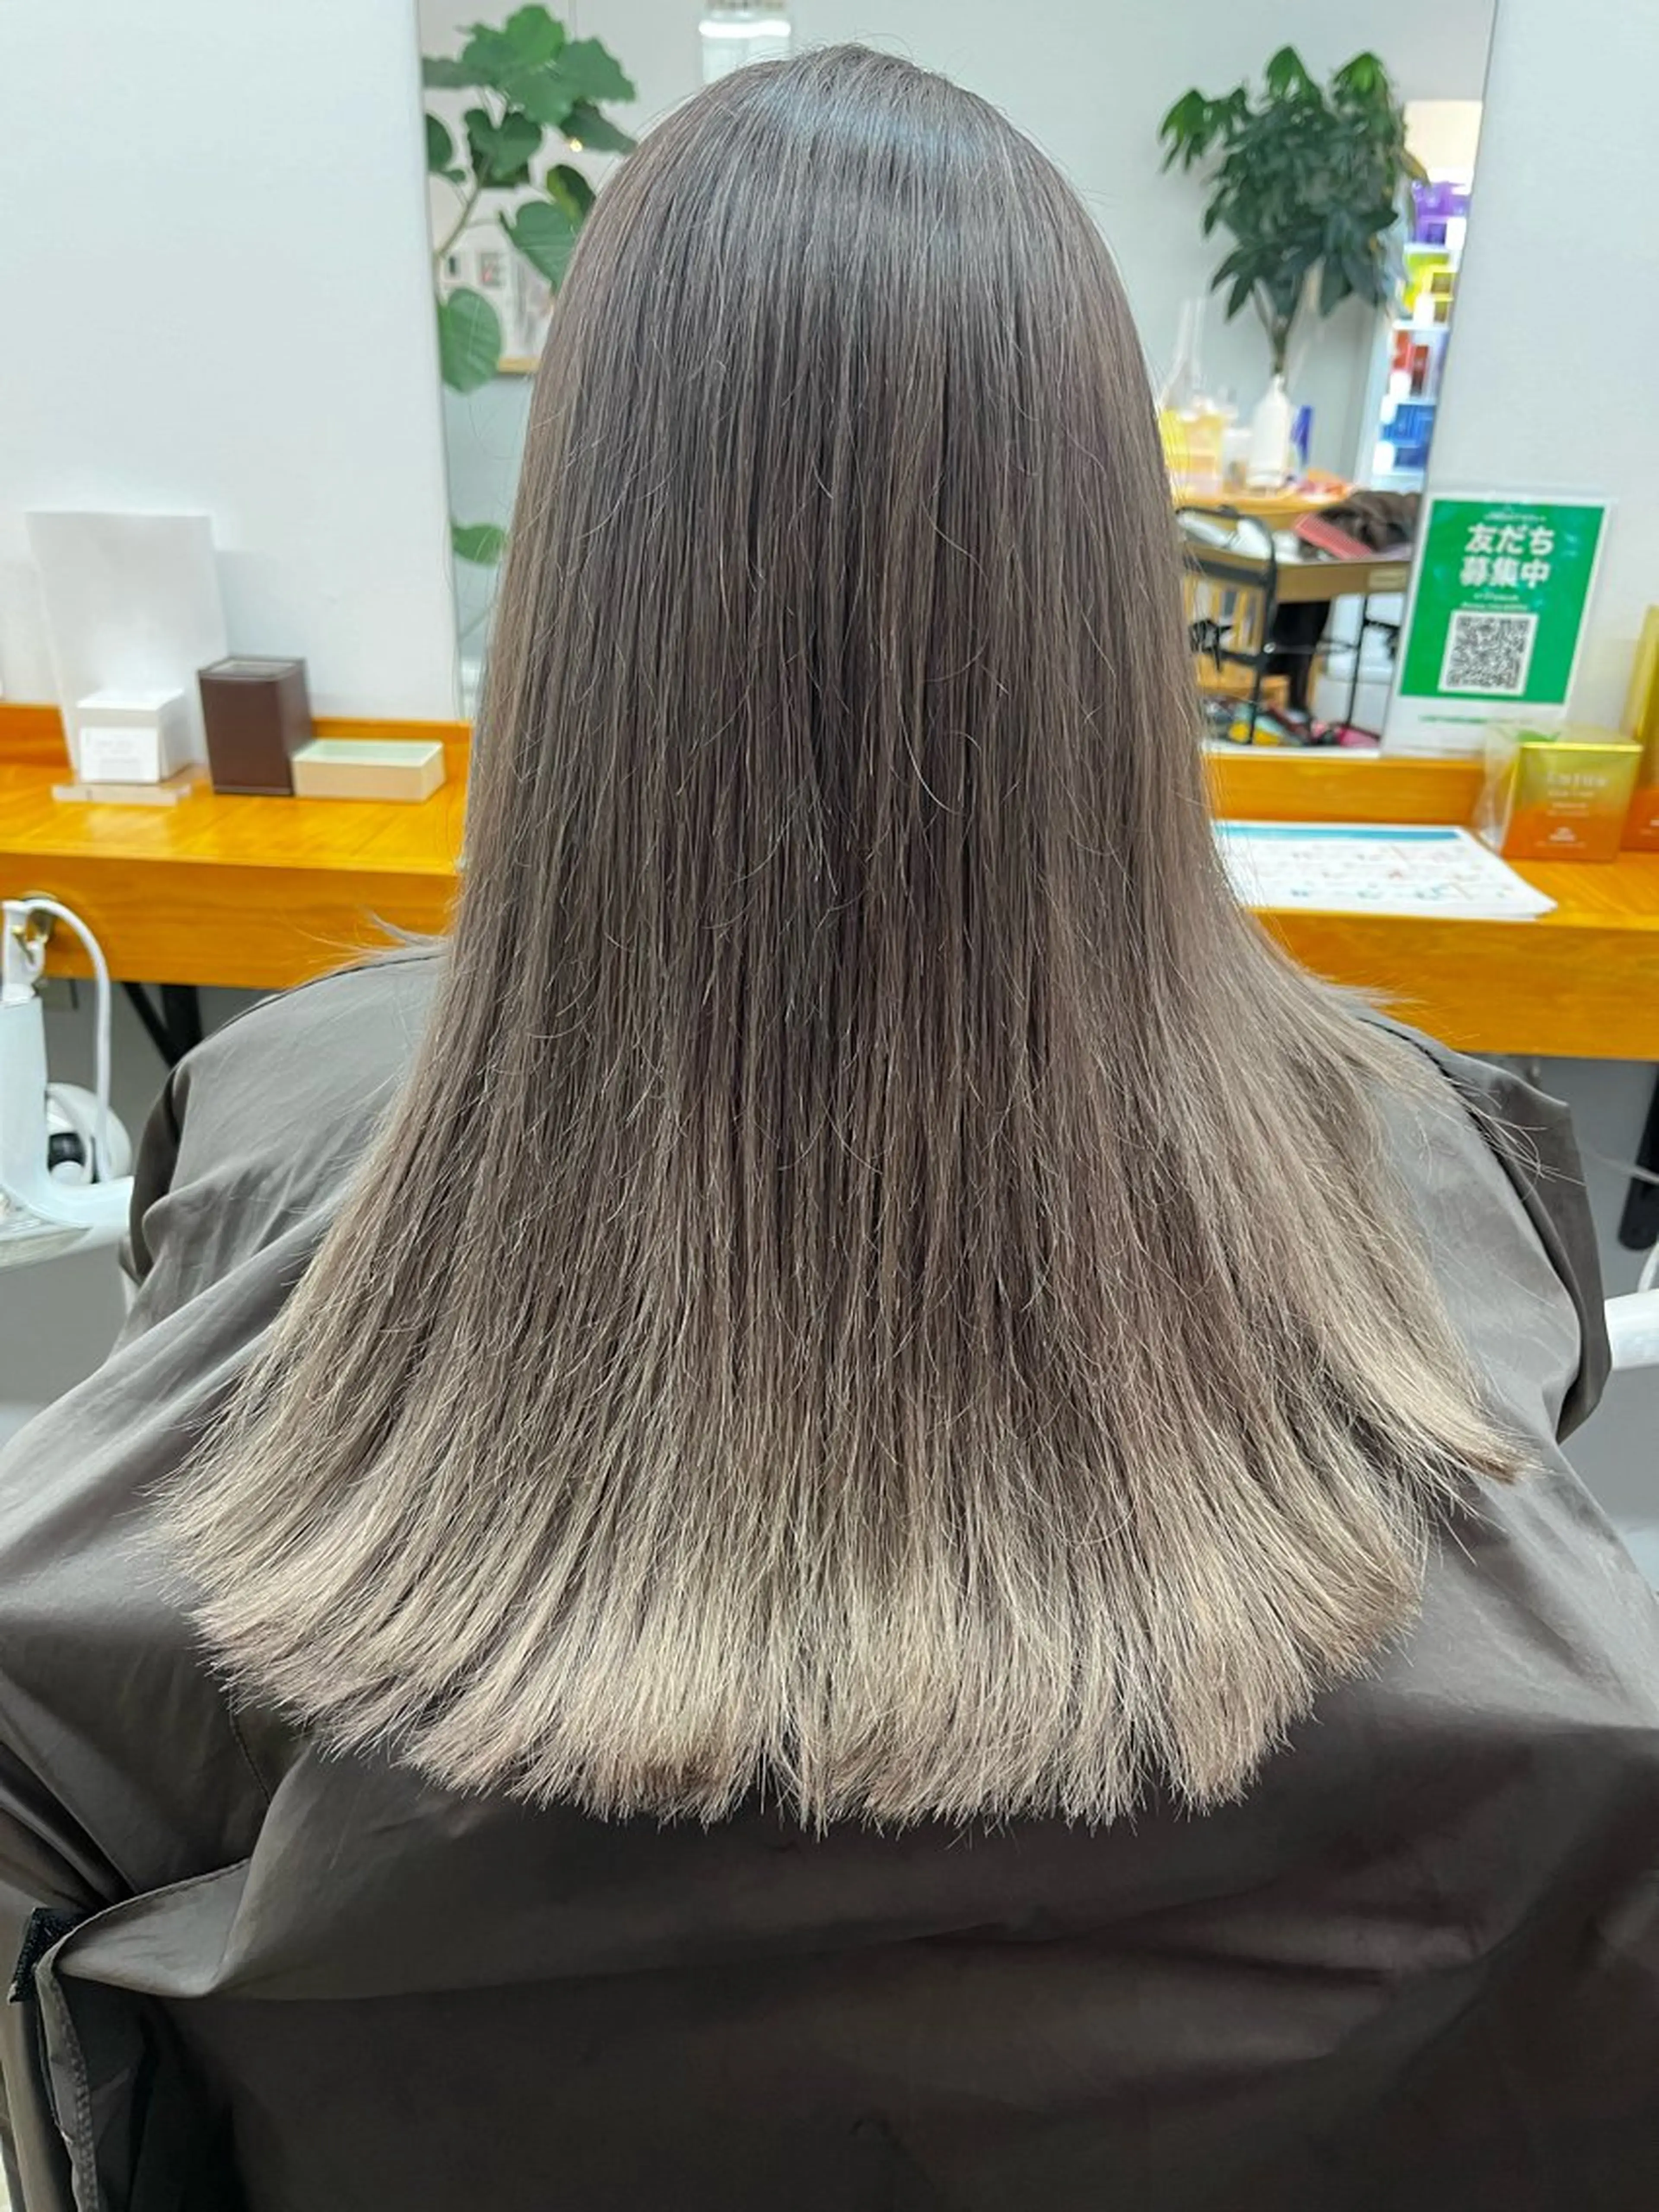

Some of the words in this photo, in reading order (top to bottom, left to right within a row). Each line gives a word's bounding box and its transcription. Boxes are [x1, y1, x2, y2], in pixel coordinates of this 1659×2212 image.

[1465, 523, 1554, 556] 友だち
[1460, 556, 1551, 589] 募集中
